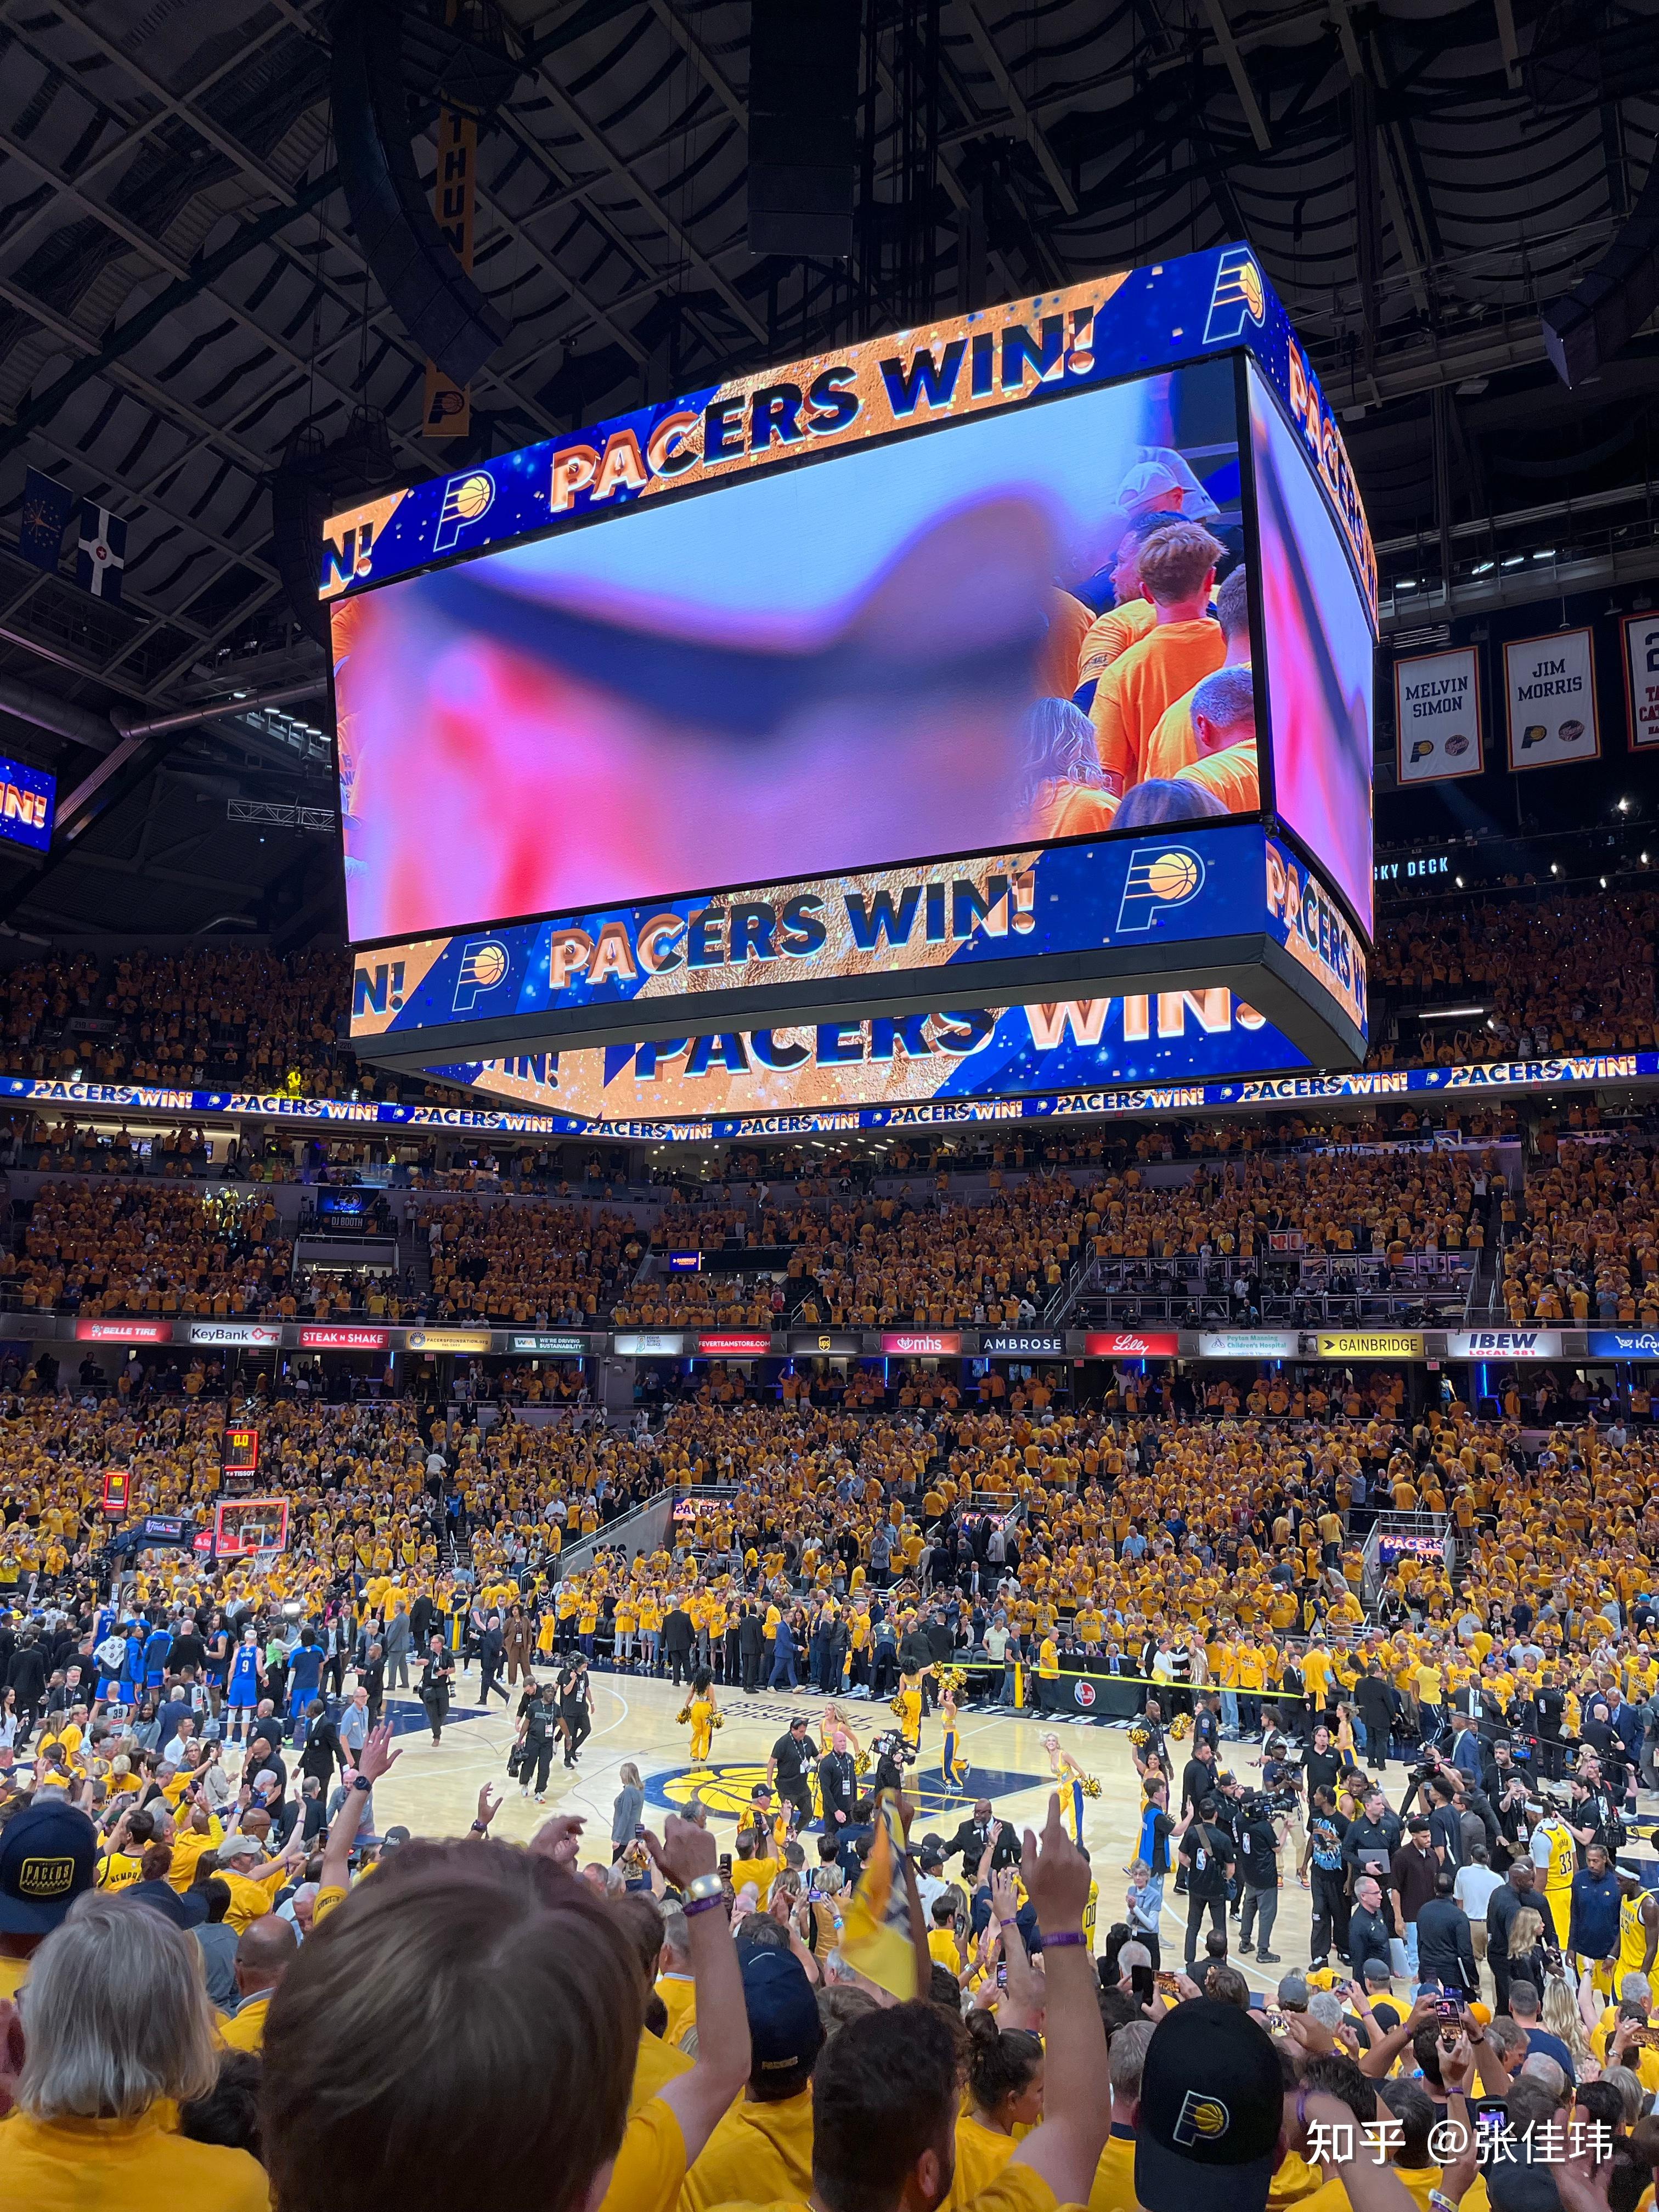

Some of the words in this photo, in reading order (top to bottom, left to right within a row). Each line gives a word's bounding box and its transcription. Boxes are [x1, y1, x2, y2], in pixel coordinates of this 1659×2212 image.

[550, 365, 860, 513] PACERS
[879, 305, 1095, 419] WIN!
[1532, 658, 1566, 678] JIM
[1406, 676, 1468, 701] MELVIN
[1517, 676, 1583, 702] MORRIS
[1413, 696, 1463, 718] SIMON
[1408, 856, 1448, 877] DECK
[1266, 840, 1351, 992] PACERS
[549, 894, 827, 990] PACERS
[844, 870, 1036, 952] WIN!
[352, 961, 405, 1018] N!
[1452, 1059, 1562, 1086] PACERS
[1568, 1056, 1637, 1081] WIN!
[35, 1082, 133, 1103] PACERS
[138, 1088, 193, 1109] WIN!
[1244, 1076, 1343, 1102] PACERS
[1350, 1071, 1408, 1096] WIN!
[231, 1095, 322, 1117] PACERS
[328, 1103, 378, 1122] WIN!
[1058, 1090, 1145, 1113] PACERS
[1150, 1087, 1205, 1109] WIN!
[414, 1107, 500, 1128] PACERS
[505, 1113, 553, 1132] WIN!
[891, 1103, 970, 1125] PACERS
[974, 1101, 1023, 1120] WIN!
[587, 1121, 665, 1140] PACERS
[670, 1123, 713, 1141] WIN!
[741, 1115, 812, 1136] PACERS
[817, 1113, 860, 1132] WIN!
[332, 1216, 340, 1226] DJ
[341, 1217, 363, 1227] BOOTH
[103, 1327, 133, 1336] BELLE
[135, 1327, 157, 1336] TIRE
[192, 1328, 249, 1343] KeyBank
[302, 1332, 337, 1342] STEAK
[347, 1333, 384, 1344] SHAKE
[1469, 1334, 1538, 1348] IBEW
[914, 1336, 942, 1350] mhs
[984, 1339, 1062, 1350] AMBROSE
[1113, 1334, 1149, 1355] Lilly
[1340, 1338, 1418, 1351] GAINBRIDGE
[1384, 1538, 1444, 1550] PACERS
[105, 1622, 111, 1633] 7
[242, 1660, 249, 1673] 9
[114, 1708, 123, 1719] 39
[1559, 1850, 1572, 1875] 33
[1086, 1903, 1096, 1928] 00
